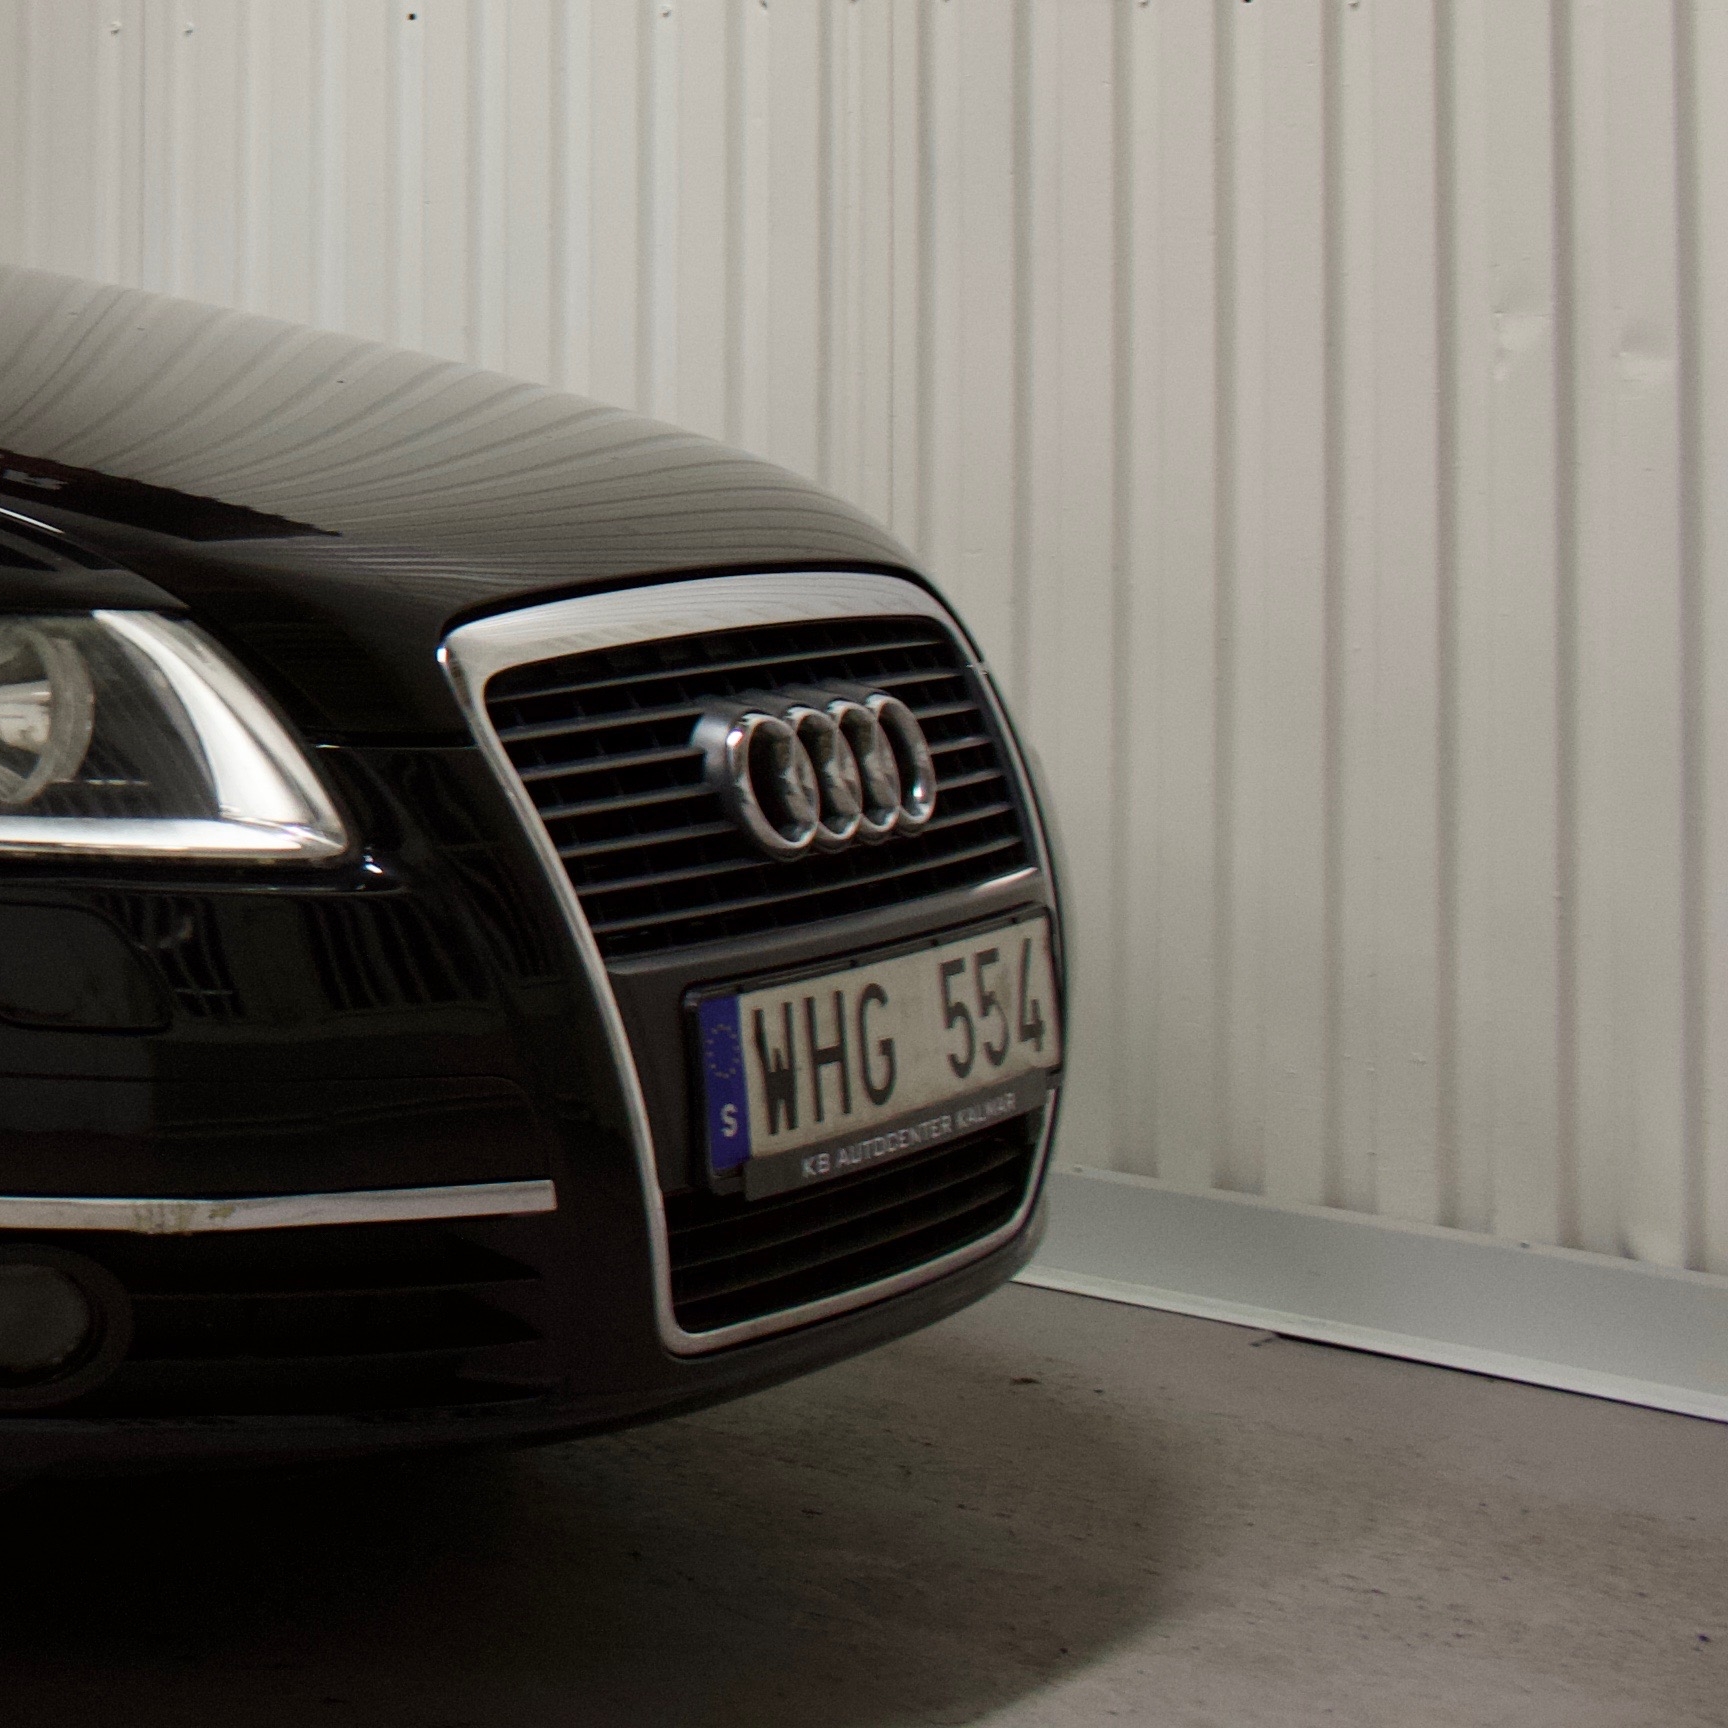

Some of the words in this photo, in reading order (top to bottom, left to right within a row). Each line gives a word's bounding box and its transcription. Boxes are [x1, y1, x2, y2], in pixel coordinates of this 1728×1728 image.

[751, 982, 896, 1136] WHG
[939, 937, 1044, 1079] 554
[720, 1104, 739, 1138] S
[801, 1152, 831, 1179] KB
[836, 1114, 953, 1168] AUTOCENTER
